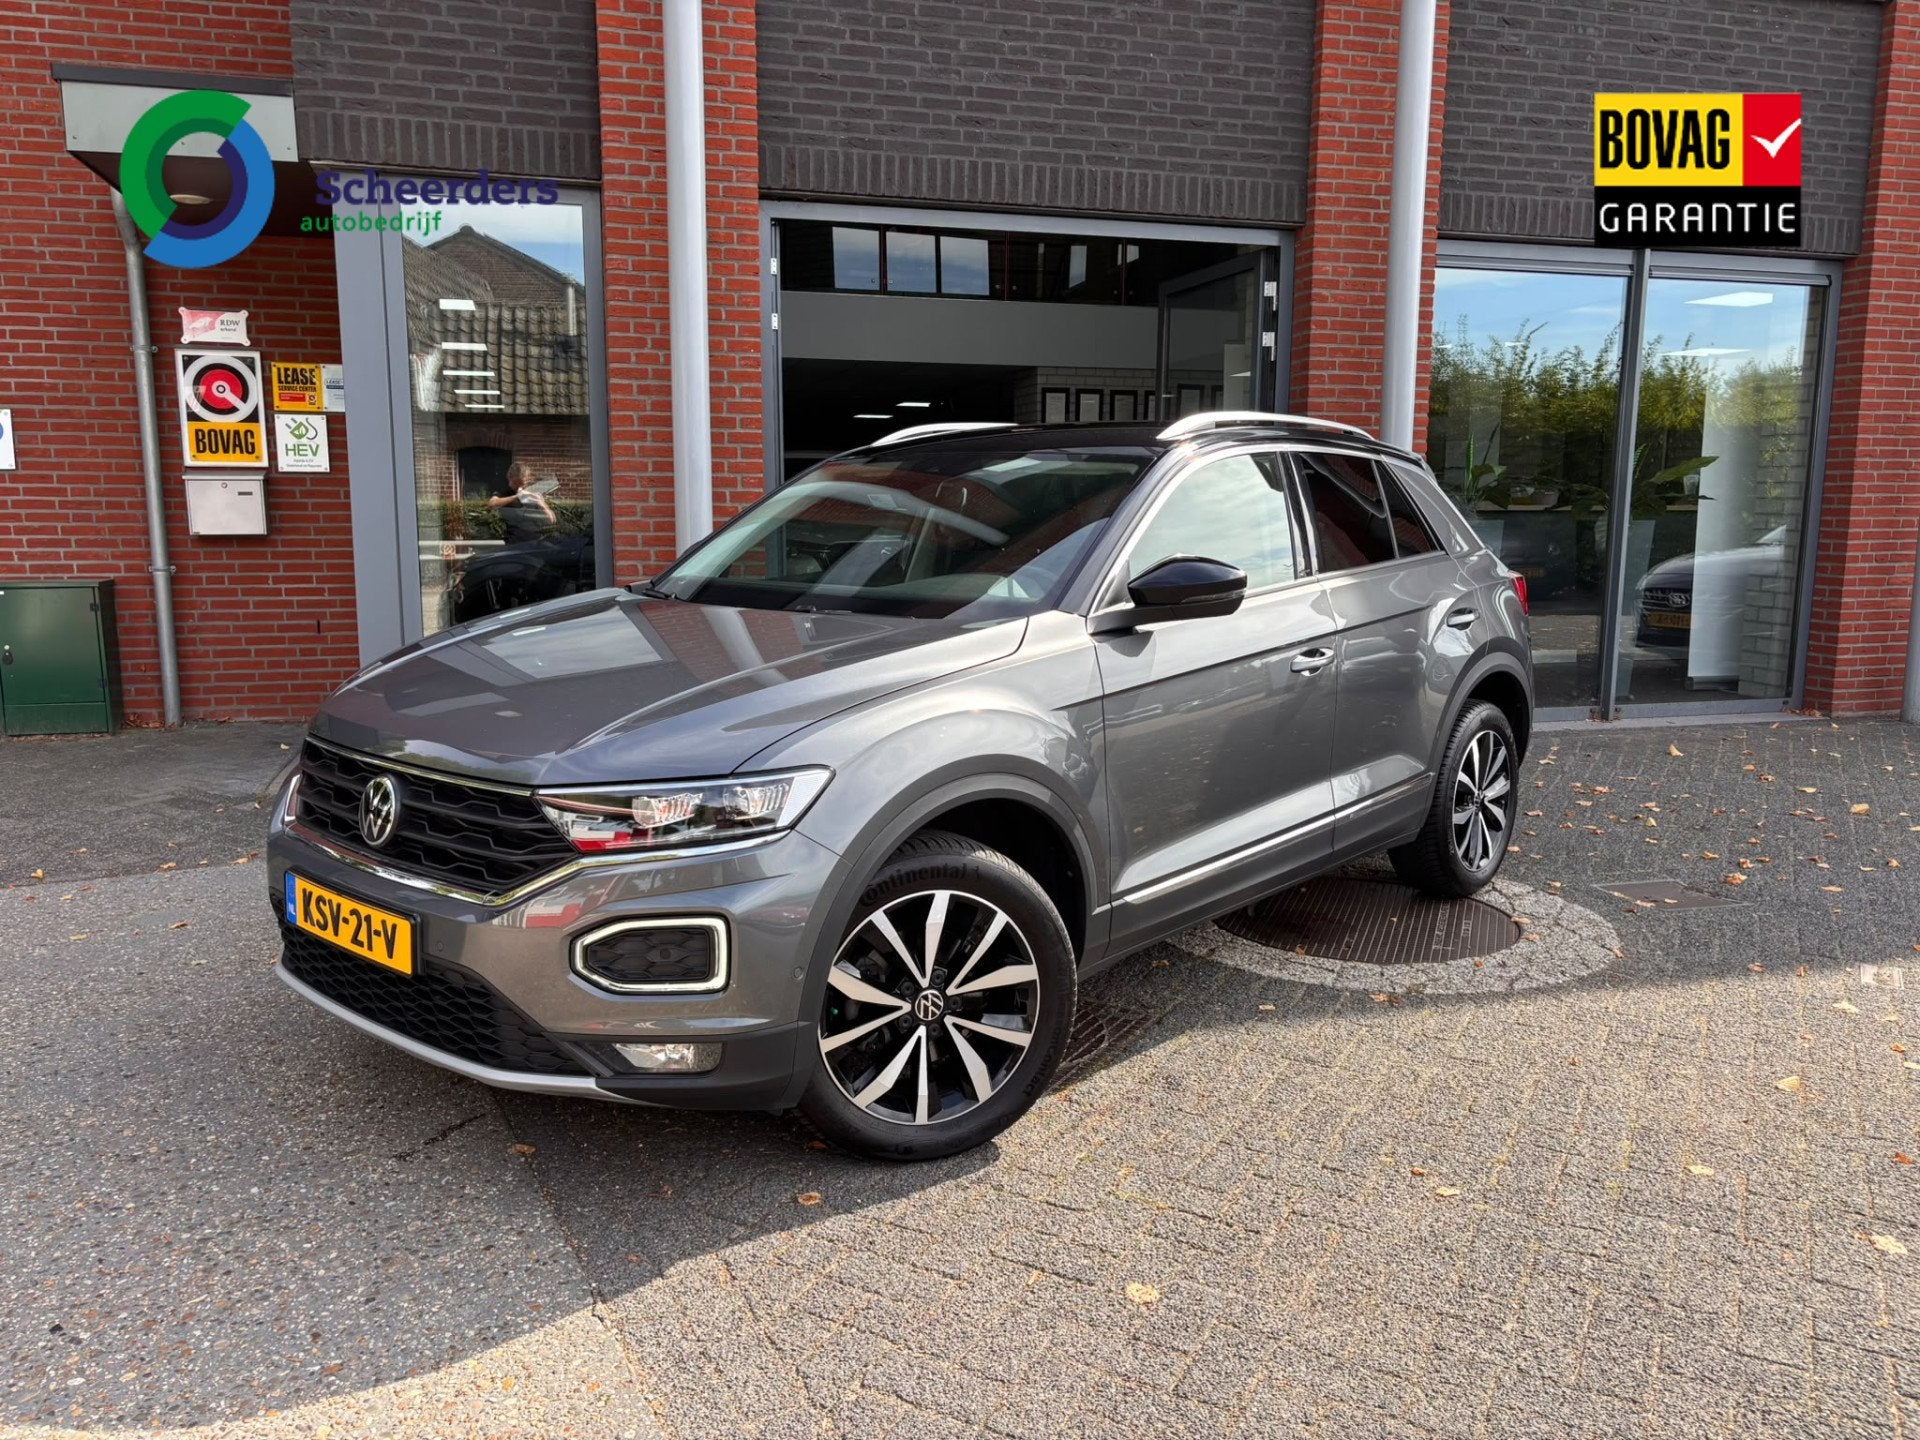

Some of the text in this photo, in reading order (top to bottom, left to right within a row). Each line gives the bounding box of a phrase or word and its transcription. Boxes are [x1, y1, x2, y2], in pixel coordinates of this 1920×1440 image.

[277, 367, 316, 385] LEASE
[194, 428, 256, 455] BOVAG
[285, 443, 320, 457] HEV
[302, 888, 397, 959] KSV-21-V
